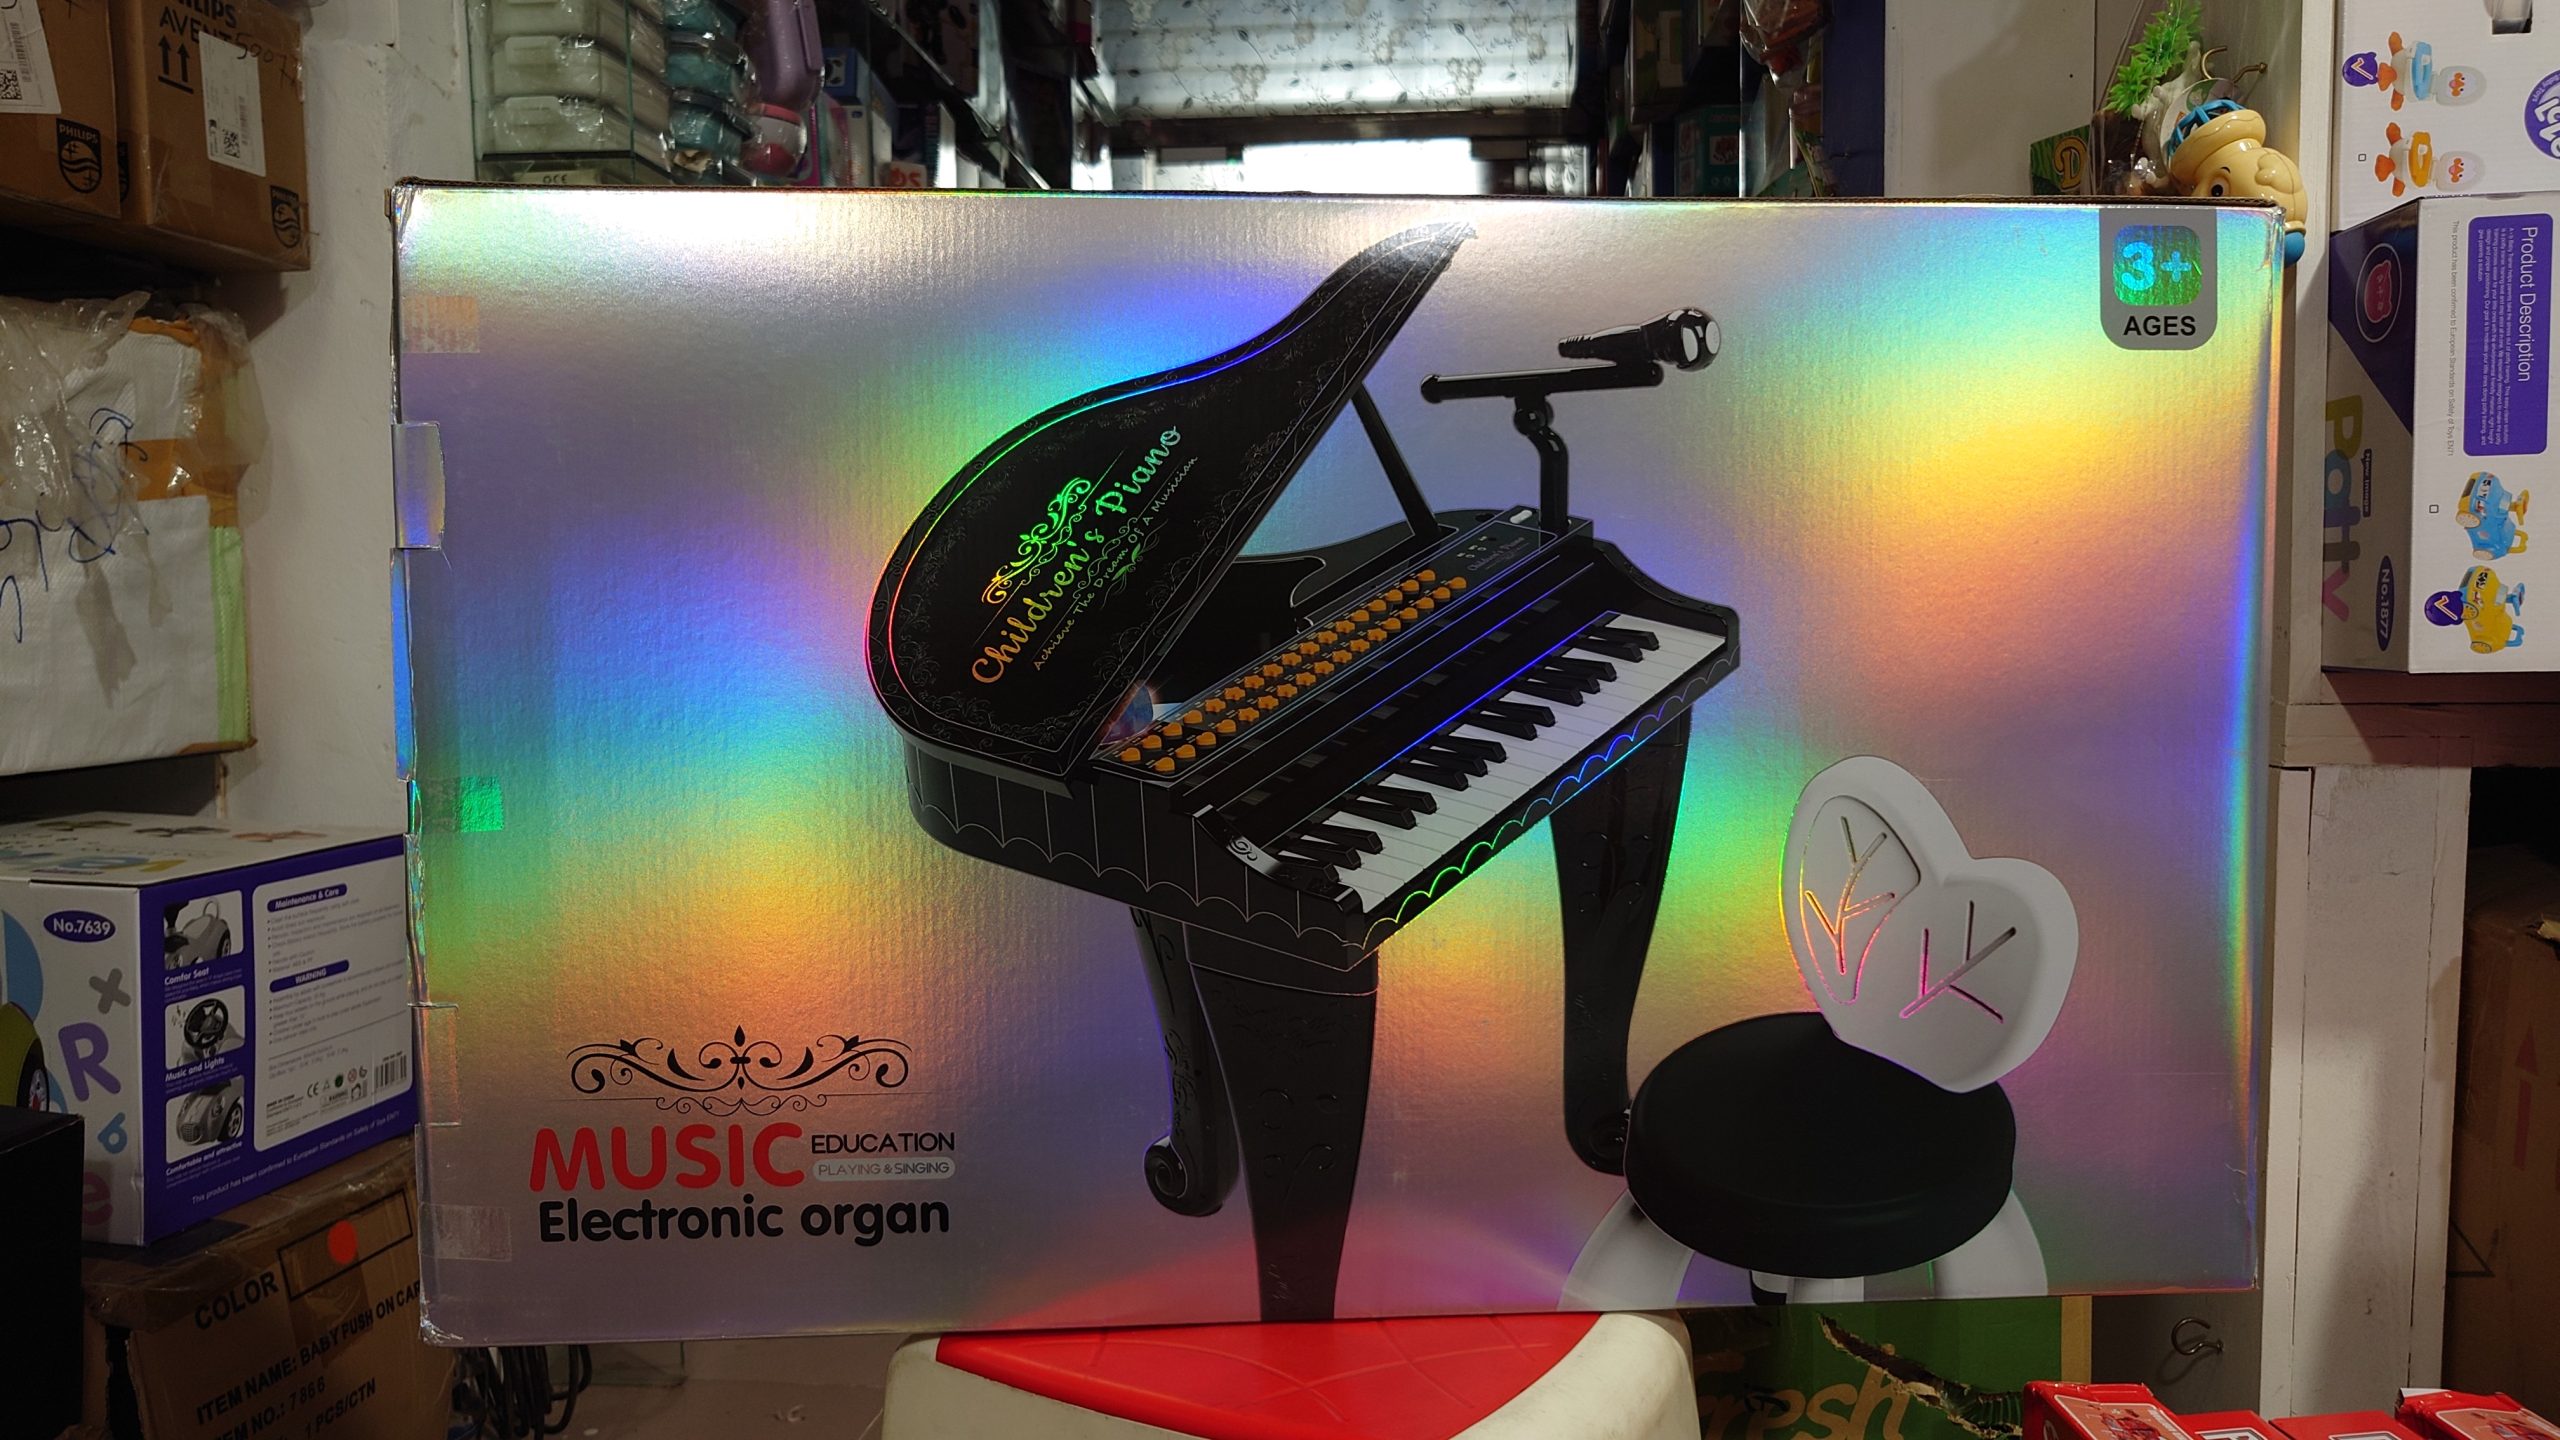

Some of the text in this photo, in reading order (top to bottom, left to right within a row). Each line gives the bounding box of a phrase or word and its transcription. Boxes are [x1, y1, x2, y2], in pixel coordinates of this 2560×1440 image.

[59, 123, 99, 144] PHILIPS
[2121, 241, 2193, 291] 3+
[2122, 315, 2197, 337] AGES
[2514, 226, 2539, 383] Product Description
[971, 425, 1182, 685] Children's Piano
[1033, 618, 1075, 671] Achieve
[1073, 592, 1095, 614] The
[1093, 547, 1129, 588] Dream
[1143, 515, 1154, 526] A
[1151, 456, 1198, 512] Musician
[2378, 568, 2391, 640] No.1877
[274, 891, 317, 910] Maintenance
[53, 917, 112, 937] No.7639
[193, 967, 210, 980] Seat
[294, 967, 328, 984] WARNING
[58, 1022, 122, 1102] R
[165, 1056, 226, 1083] Music and Lights
[166, 1140, 243, 1177] Comfortable and attractive
[529, 1122, 805, 1193] MUSIC
[810, 1131, 955, 1154] EDUCATION
[818, 1162, 881, 1177] PLAYING
[893, 1160, 950, 1175] SINGING
[539, 1193, 950, 1248] Electronic organ
[194, 1271, 279, 1330] COLOR
[195, 1386, 242, 1425] ITEM
[244, 1357, 298, 1399] NAME:
[299, 1330, 340, 1368] BABY
[341, 1309, 374, 1340] PUSH
[375, 1296, 395, 1320] ON
[251, 1402, 286, 1434] NO.:
[315, 1377, 376, 1433] PCS/CTN
